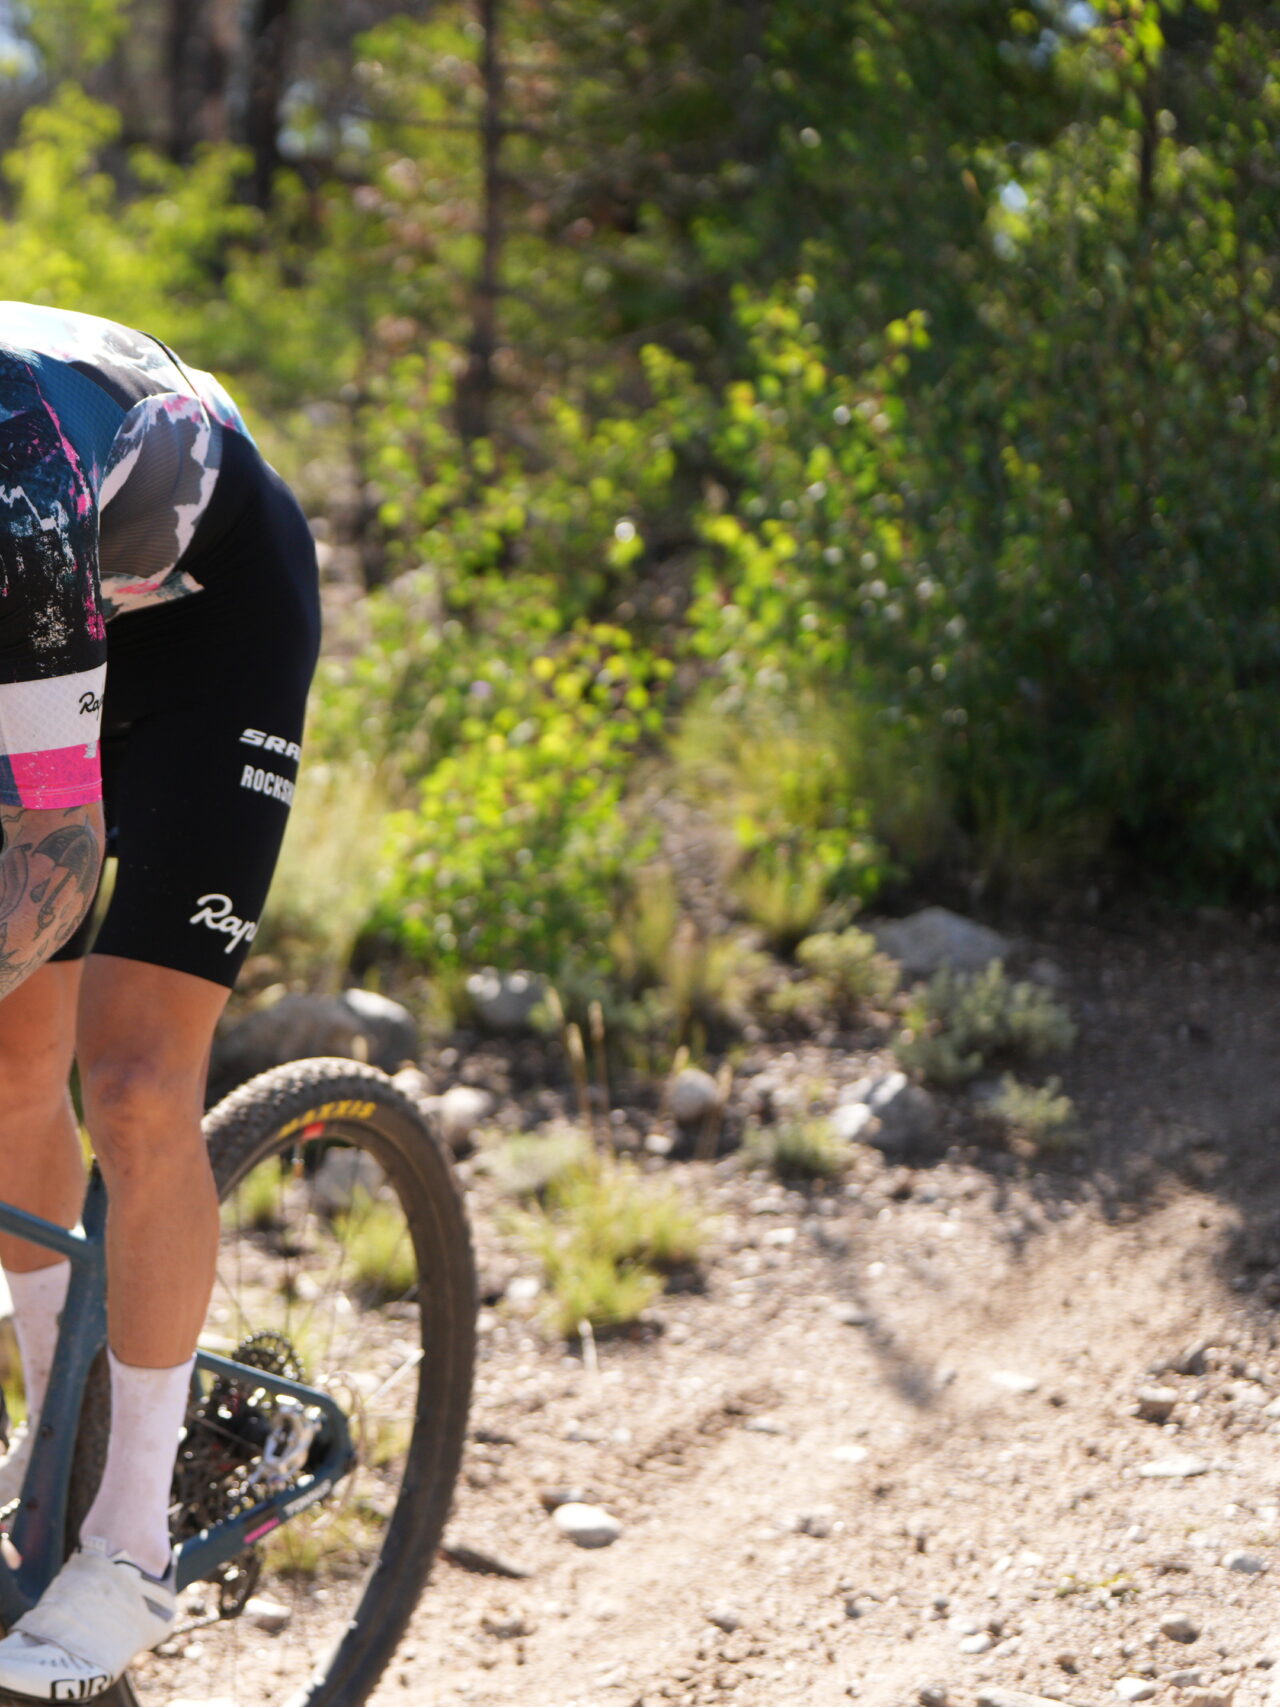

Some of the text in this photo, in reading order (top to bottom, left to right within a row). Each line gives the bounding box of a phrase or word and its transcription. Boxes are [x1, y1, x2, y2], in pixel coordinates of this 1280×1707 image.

[239, 727, 302, 763] SRA
[240, 764, 295, 807] ROCKS
[189, 893, 258, 954] Rap
[50, 1673, 114, 1700] GIR
